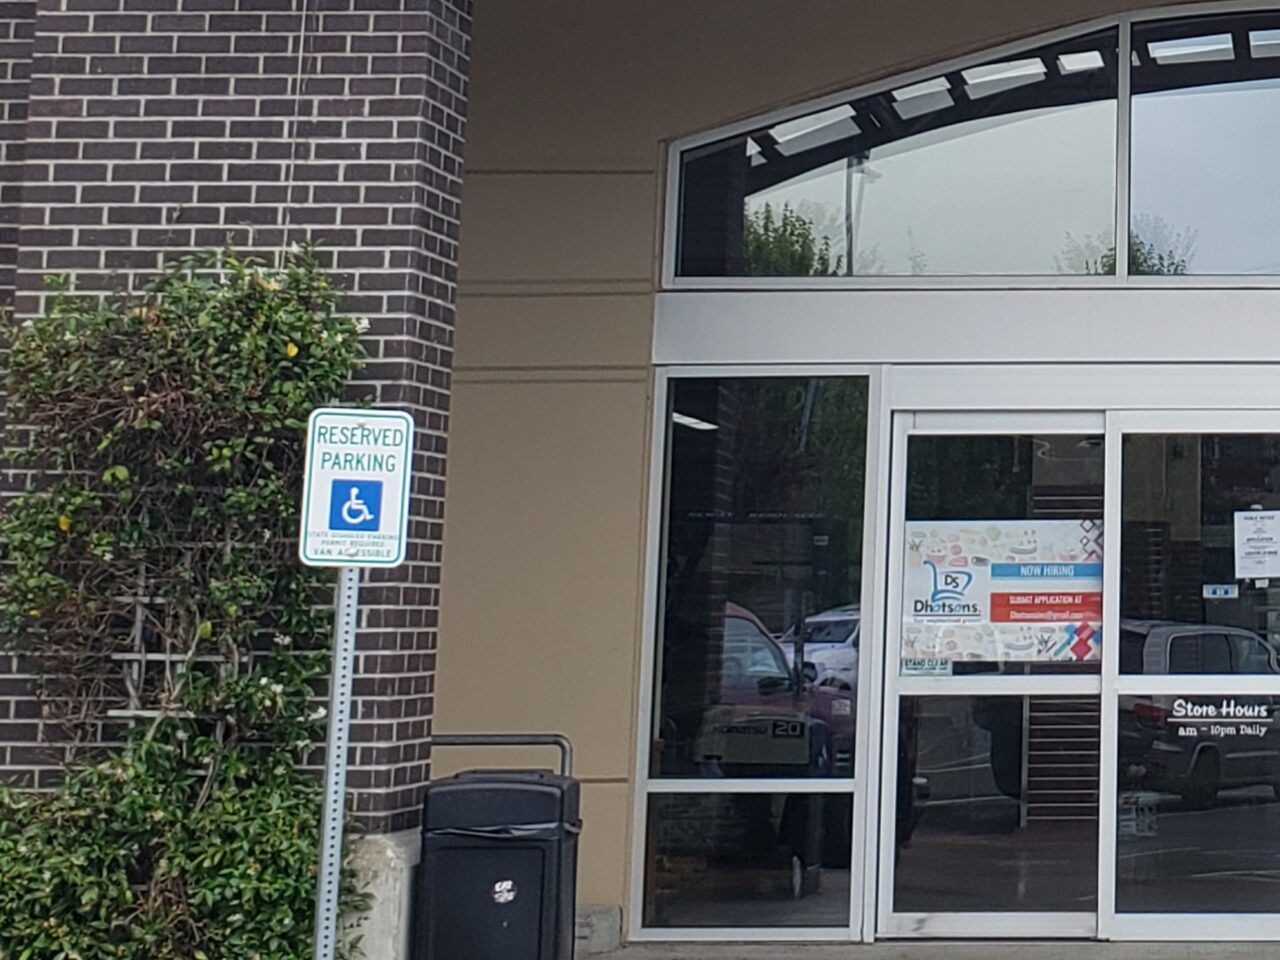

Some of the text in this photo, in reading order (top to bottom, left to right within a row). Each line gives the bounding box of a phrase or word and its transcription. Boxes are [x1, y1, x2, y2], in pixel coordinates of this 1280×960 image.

[317, 425, 404, 447] RESERVED
[320, 451, 397, 472] PARKING
[313, 549, 392, 558] VAN ACESSIBLE
[1020, 565, 1075, 576] NOW HIRING
[944, 574, 960, 589] DS
[1034, 595, 1074, 604] APPLICATION
[1172, 699, 1268, 717] Store Hours
[774, 722, 802, 736] 20
[1210, 725, 1237, 737] 10pm
[1239, 724, 1268, 737] Daily
